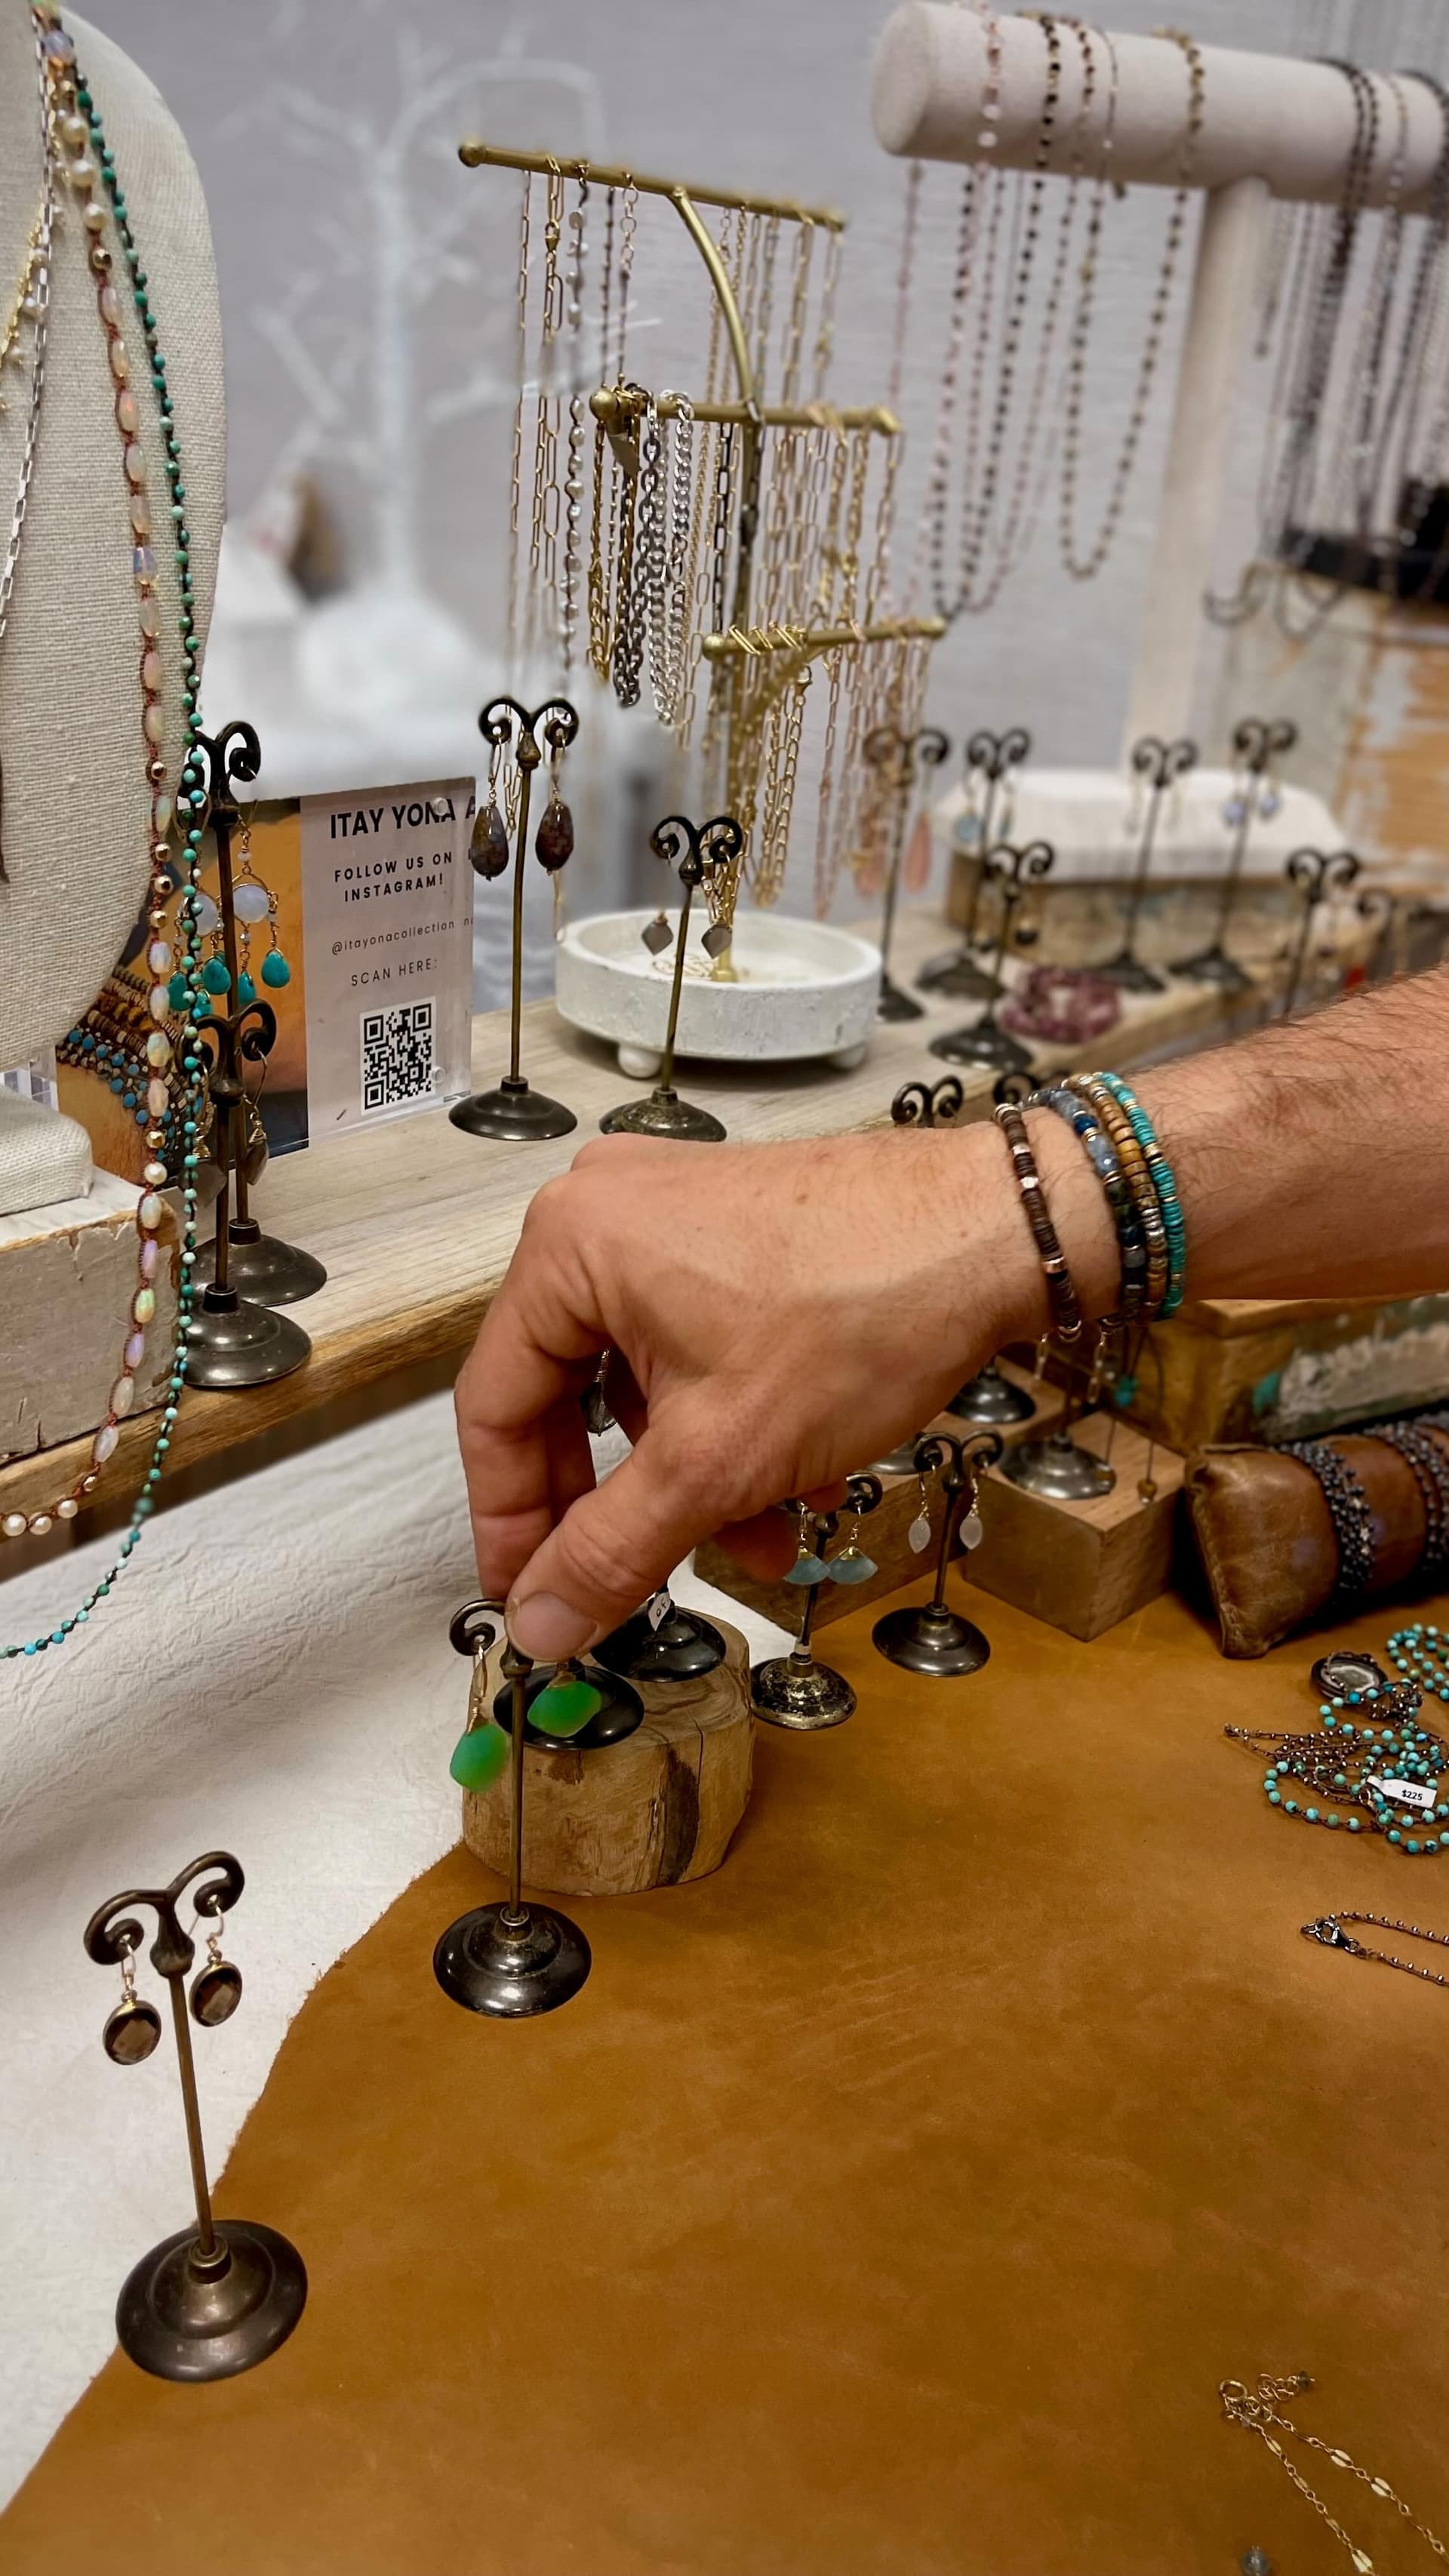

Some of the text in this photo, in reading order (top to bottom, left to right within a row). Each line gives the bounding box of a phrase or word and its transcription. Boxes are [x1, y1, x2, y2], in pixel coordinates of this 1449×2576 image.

[331, 808, 384, 839] ITAY
[391, 799, 456, 829] YONA
[334, 860, 397, 882] FOLLOW
[405, 856, 423, 870] US
[432, 851, 452, 865] ON
[344, 873, 444, 902] INSTAGRAM!
[331, 920, 454, 956] @itayonacollection
[351, 958, 438, 986] SCAN HERE:
[1401, 1790, 1423, 1801] $225
